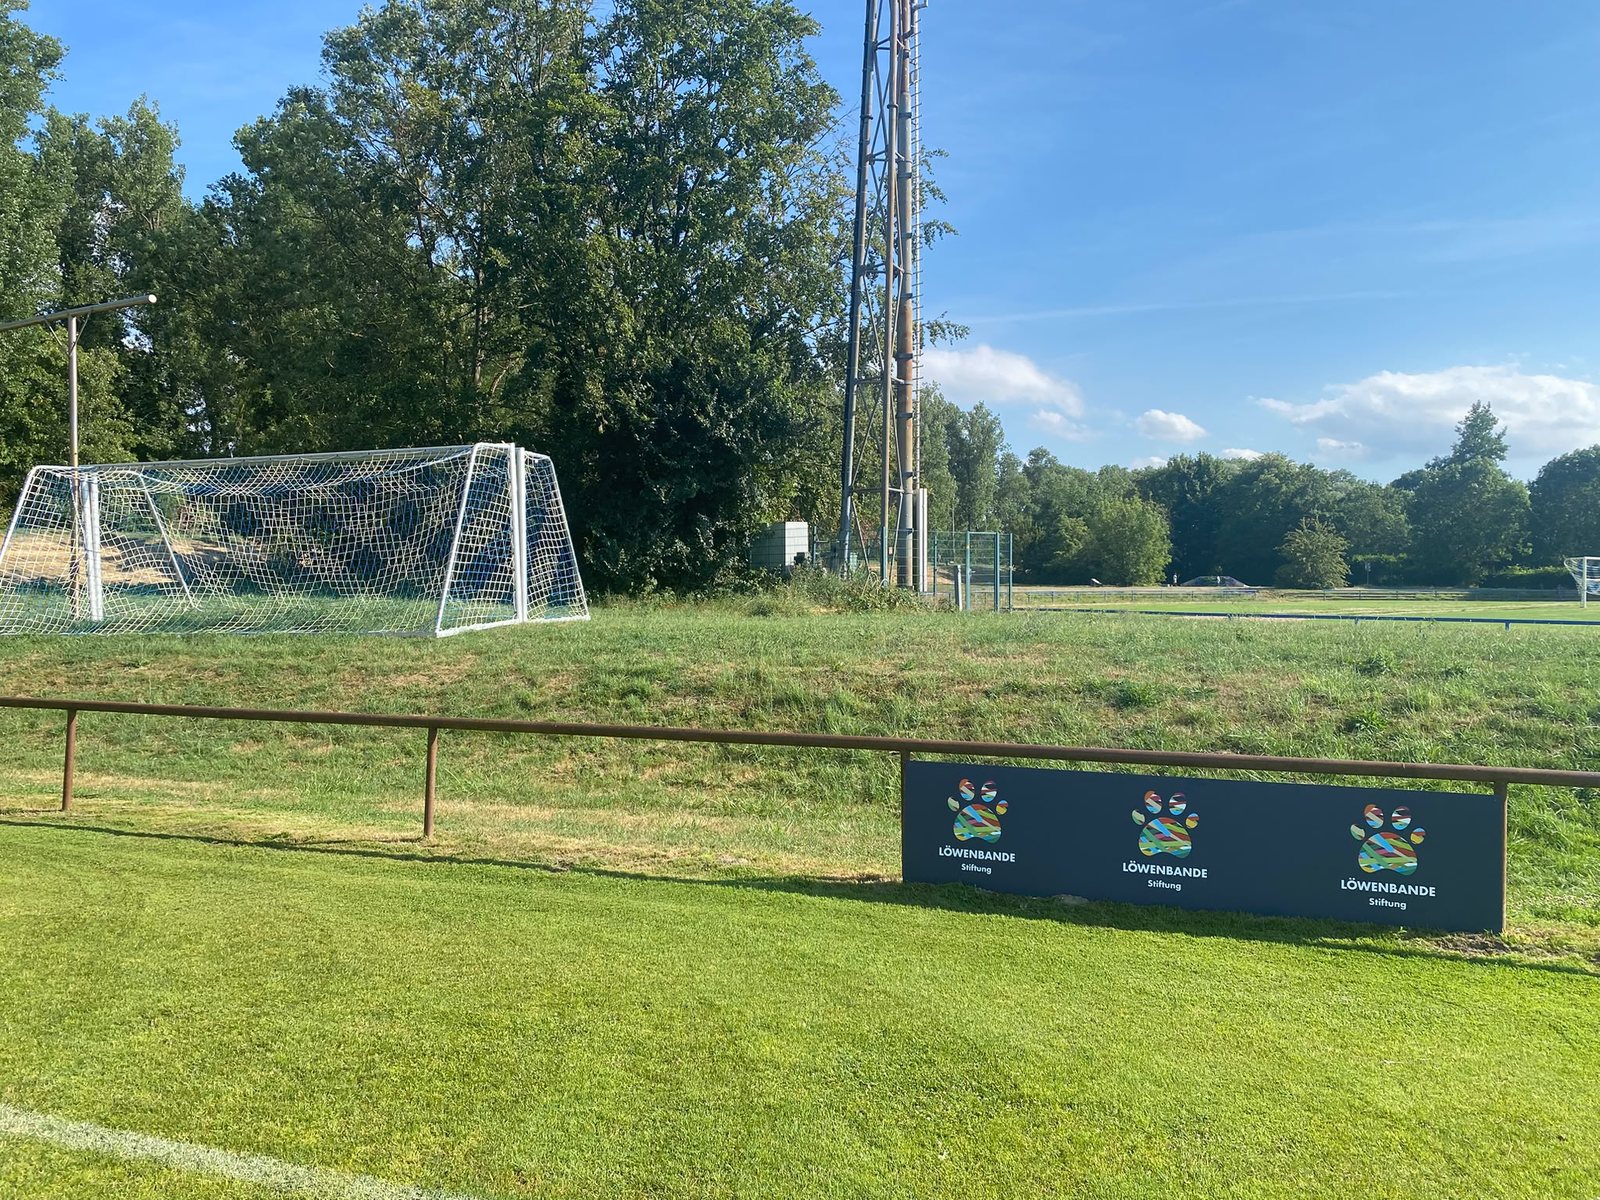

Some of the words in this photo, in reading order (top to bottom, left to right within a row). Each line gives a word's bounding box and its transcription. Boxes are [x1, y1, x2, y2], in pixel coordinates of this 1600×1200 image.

[938, 844, 1016, 863] LÖWENBANDE
[960, 863, 992, 875] Stiftung
[1122, 860, 1208, 879] LÖWENBANDE
[1147, 879, 1182, 892] Stiftung
[1340, 877, 1436, 897] LÖWENBANDE
[1368, 897, 1407, 911] Stiftung
